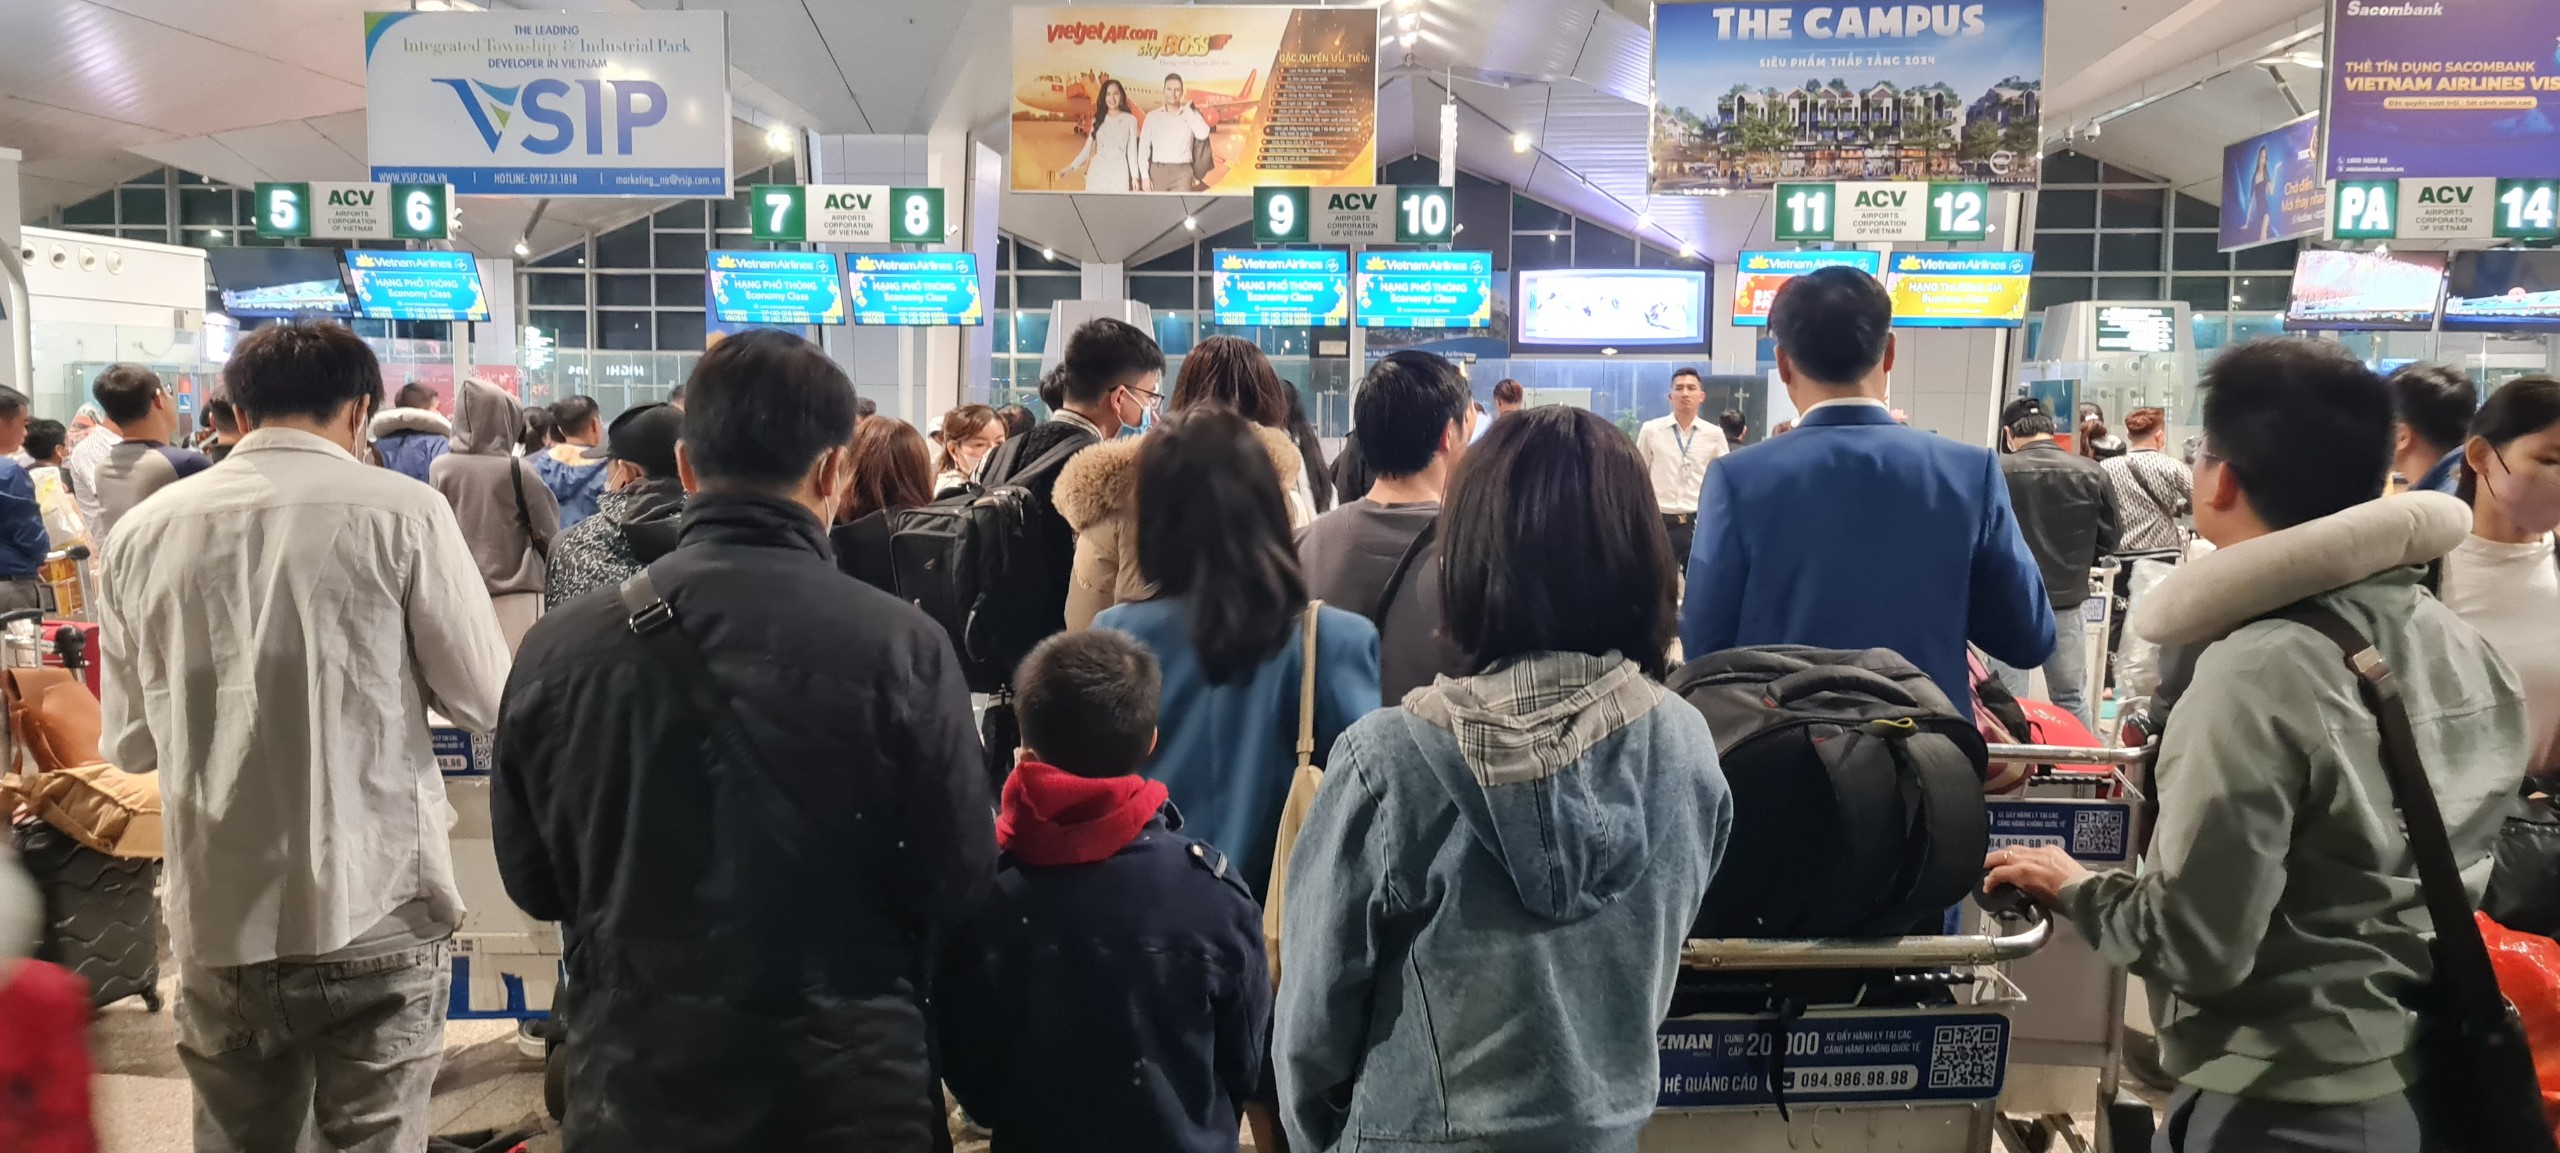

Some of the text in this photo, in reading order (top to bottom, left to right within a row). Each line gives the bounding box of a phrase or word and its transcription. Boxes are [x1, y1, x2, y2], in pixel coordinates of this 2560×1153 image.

[2346, 0, 2443, 16] Sacombank
[1712, 4, 1985, 41] THE CAMPUS
[514, 25, 580, 36] THE LEADING
[403, 38, 481, 56] Integrated
[483, 38, 557, 57] Township
[580, 38, 654, 53] Industrial
[658, 38, 691, 53] Park
[488, 58, 608, 70] DEVELOPER IN VIETNAM
[1759, 55, 1786, 68] SIÊU
[1905, 55, 1936, 66] 2024
[2345, 58, 2536, 75] THẺ TÍN DỤNG SACOMBANK
[2344, 76, 2433, 92] VIETNAM
[2436, 76, 2526, 92] AIRLINES
[430, 78, 668, 155] VSIP
[378, 172, 448, 184] WWW.VSIP.COM.VN
[494, 173, 528, 184] HOTLINE:
[327, 190, 376, 206] ACV
[1854, 190, 1908, 208] ACV
[2417, 186, 2474, 204] ACV
[824, 193, 873, 210] ACV
[1327, 193, 1378, 211] ACV
[2501, 186, 2553, 229] 14
[270, 189, 298, 230] 5
[335, 210, 370, 218] AIRPORTS
[406, 191, 433, 231] 6
[765, 193, 792, 233] 7
[1787, 191, 1828, 233] 11
[1934, 191, 1981, 233] 12
[2339, 186, 2390, 231] PA
[2424, 208, 2465, 216] AIRPORTS
[831, 214, 867, 222] AIRPORTS
[904, 194, 930, 236] 8
[1268, 194, 1295, 236] 9
[1402, 194, 1448, 236] 10
[327, 218, 378, 226] CORPORATION
[1327, 222, 1379, 230] CORPORATION
[2420, 224, 2468, 232] OF VIETNAM
[343, 225, 374, 233] VIETNAM
[1331, 229, 1375, 237] OF VIETNAM
[1869, 227, 1903, 235] VIETNAM
[374, 257, 453, 269] Vietnam Airlines
[735, 258, 814, 270] Vietnam Airlines
[874, 259, 953, 271] Vietnam Airlines
[1242, 258, 1323, 269] Vietnam Airlines
[1386, 260, 1468, 272] Vietnam Airlines
[1769, 258, 1813, 270] Vietnam
[1921, 259, 2007, 270] Vietnam Airlines
[387, 289, 452, 299] Economy Class
[745, 291, 810, 302] Economy Class
[884, 292, 948, 303] Economy Class
[1247, 291, 1314, 303] Economy Class
[1390, 293, 1457, 305] Economy Class
[1724, 1034, 1745, 1044] CUNG
[1825, 1031, 1836, 1041] XE
[1852, 1030, 1873, 1040] HÀNH
[1844, 1043, 1865, 1054] HÀNG
[1865, 1042, 1890, 1053] KHÔNG
[1911, 1041, 1920, 1052] TẾ
[1664, 1071, 1758, 1095] HỆ QUẢNG CÁO
[1800, 1069, 1909, 1088] 094.986.98.98
